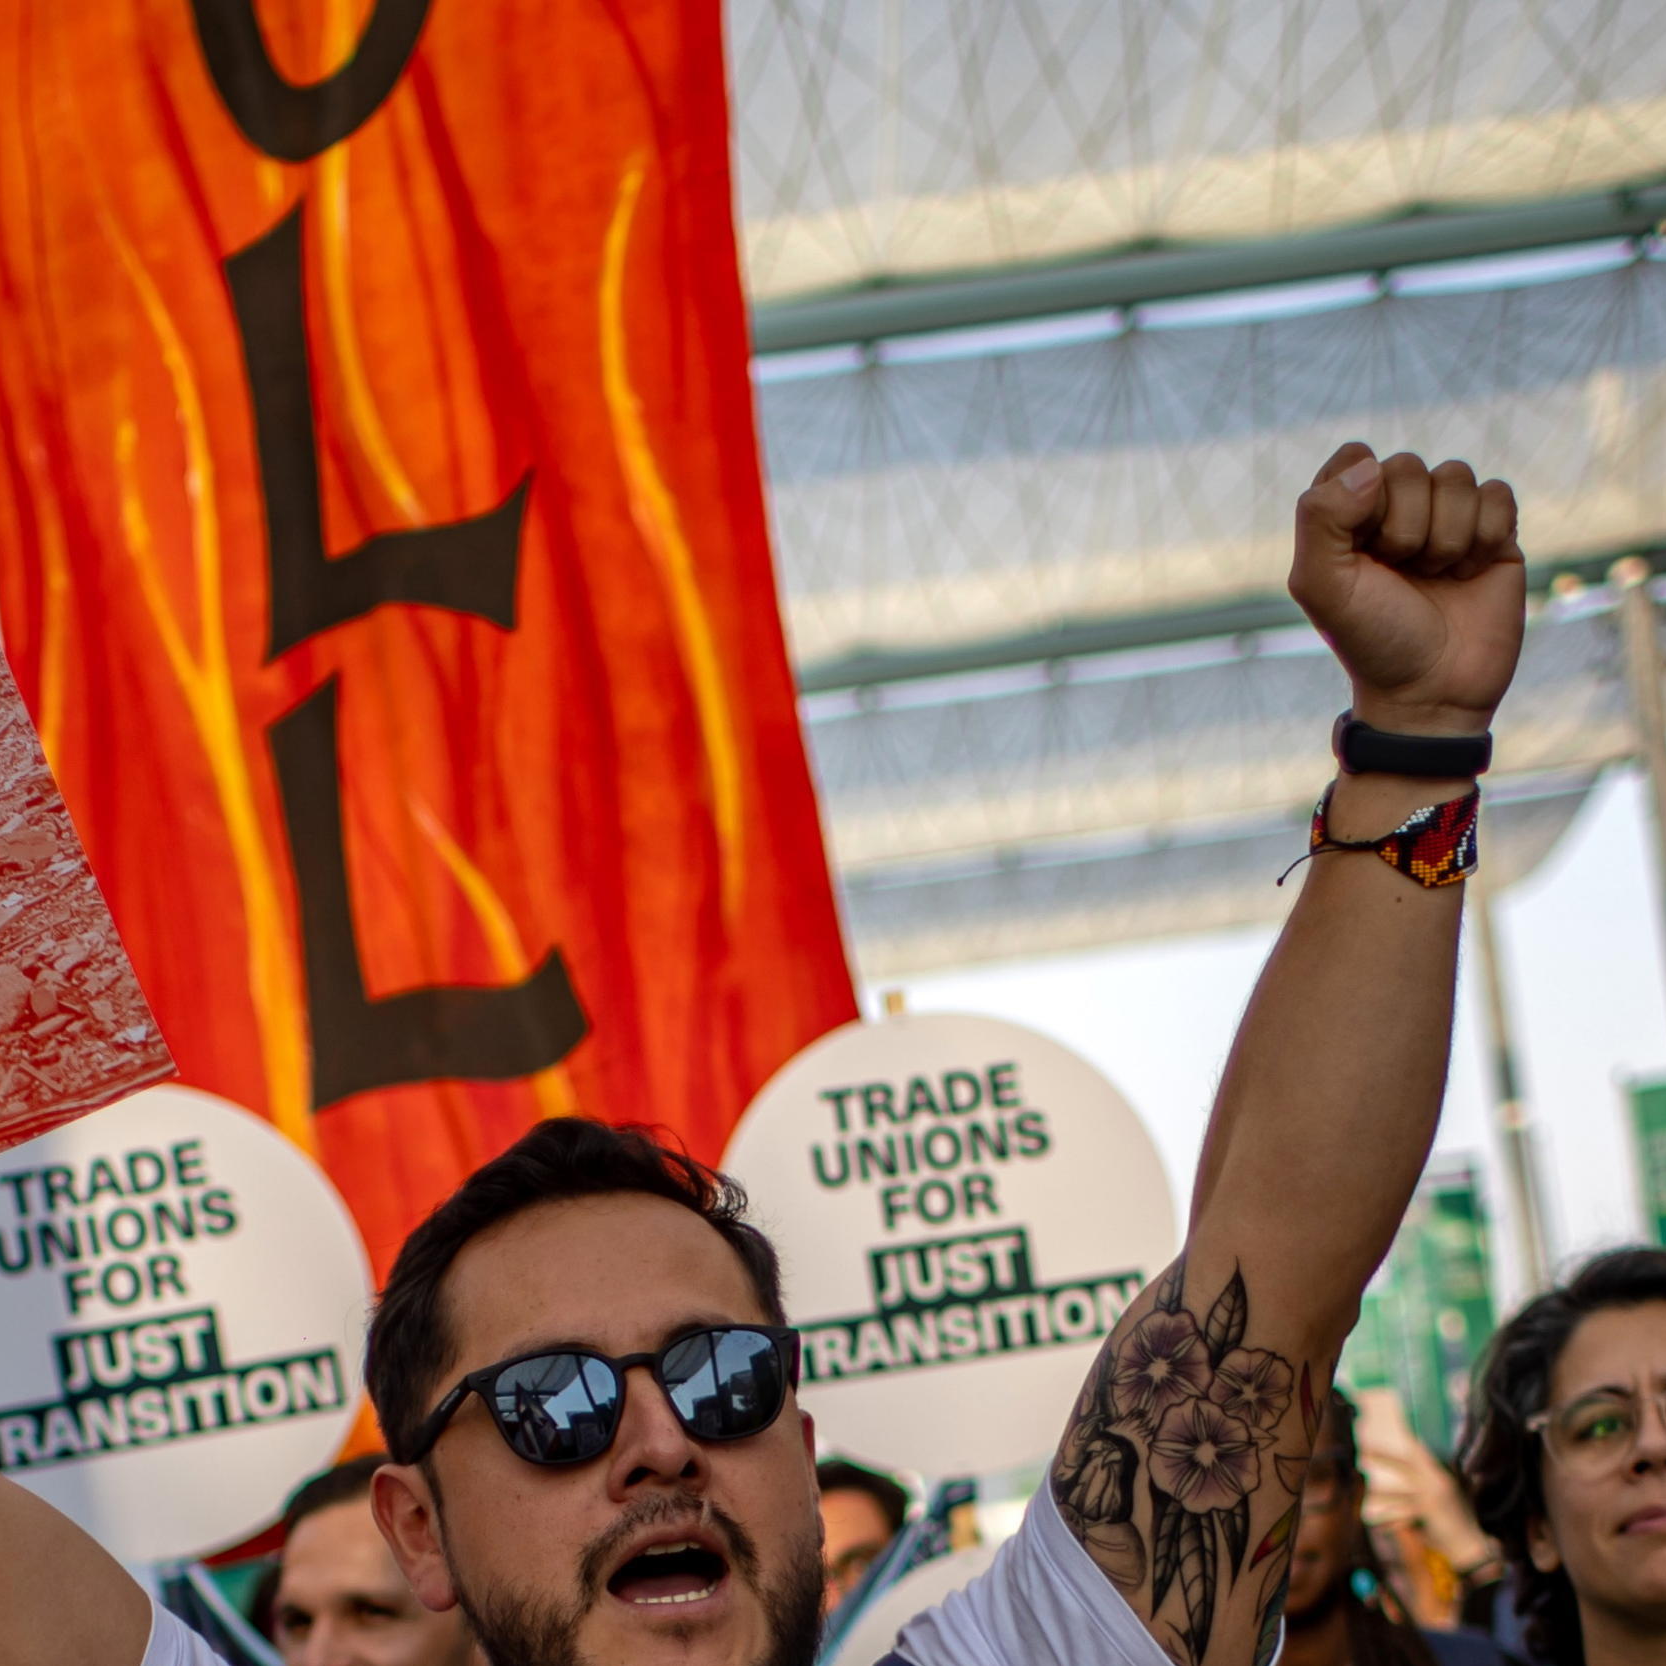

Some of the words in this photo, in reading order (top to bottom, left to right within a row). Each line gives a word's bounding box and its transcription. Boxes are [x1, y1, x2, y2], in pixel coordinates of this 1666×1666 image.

[820, 1062, 1025, 1133] TRADE
[0, 1139, 207, 1220] TRADE
[811, 1111, 1052, 1189] UNIONS
[878, 1173, 1003, 1232] FOR
[63, 1253, 190, 1317] FOR
[876, 1234, 1023, 1304] JUST
[62, 1317, 212, 1391] JUST
